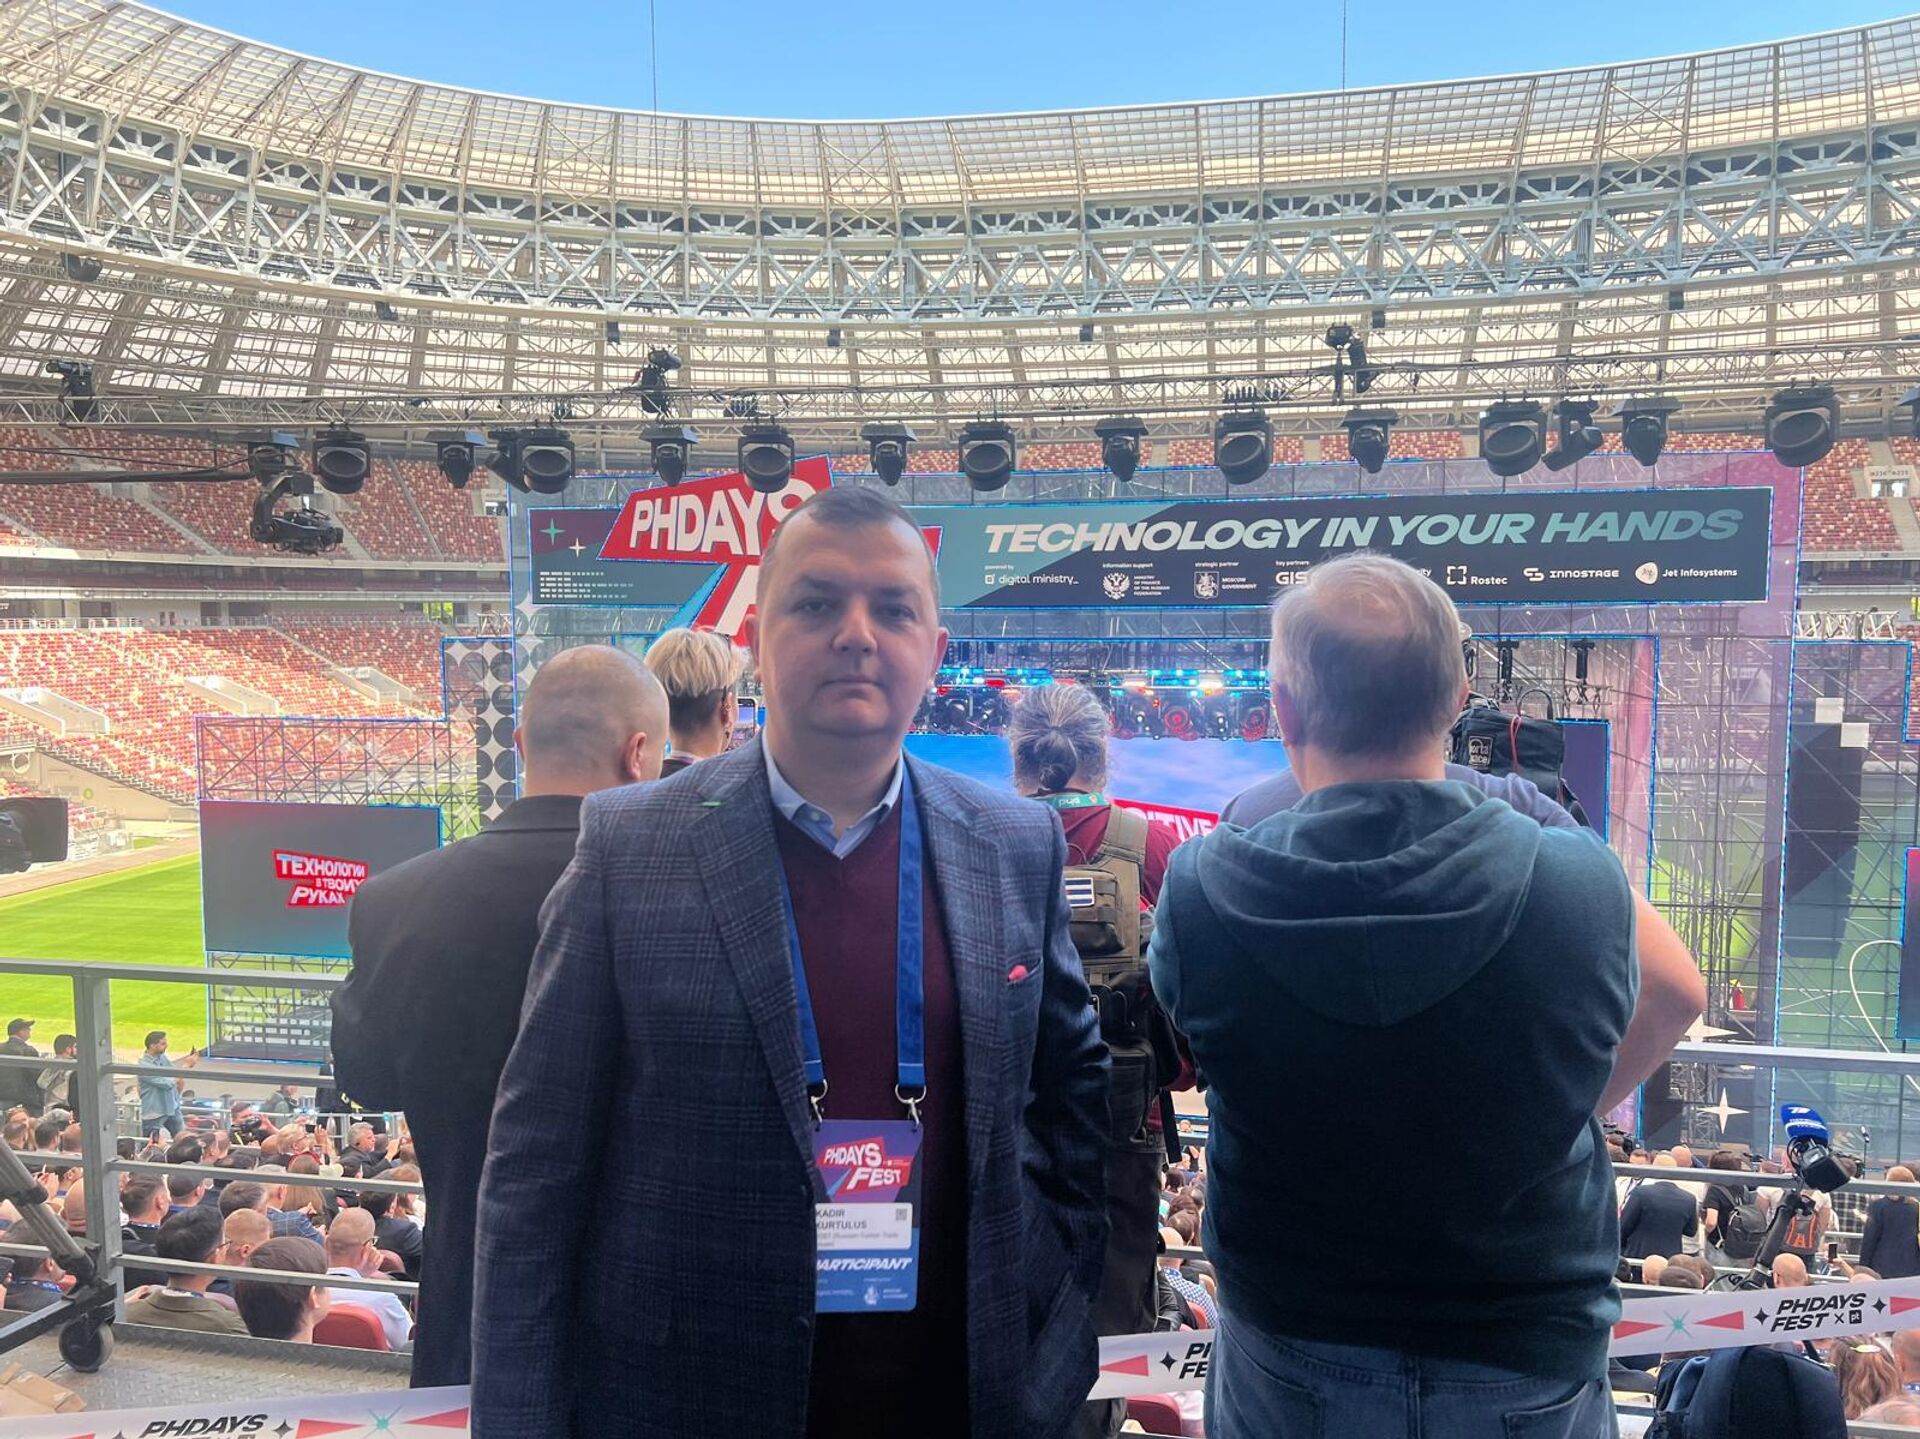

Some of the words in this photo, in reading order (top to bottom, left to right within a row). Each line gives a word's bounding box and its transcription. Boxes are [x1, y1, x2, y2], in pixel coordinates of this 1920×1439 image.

[985, 519, 1322, 553] TECHNOLOGY
[1320, 516, 1379, 547] IN
[1388, 513, 1535, 545] YOUR
[1541, 509, 1744, 543] HANDS
[999, 574, 1031, 585] digital
[1470, 576, 1508, 586] Rostec
[1662, 569, 1678, 577] Jet
[1680, 568, 1738, 578] Infosystems
[823, 1143, 882, 1168] PHDAYS
[847, 1167, 901, 1190] FEST
[1776, 1293, 1867, 1315] PHDAYS
[1770, 1313, 1830, 1332] FEST
[1179, 1361, 1208, 1379] FE
[139, 1414, 268, 1438] PHDAYS
